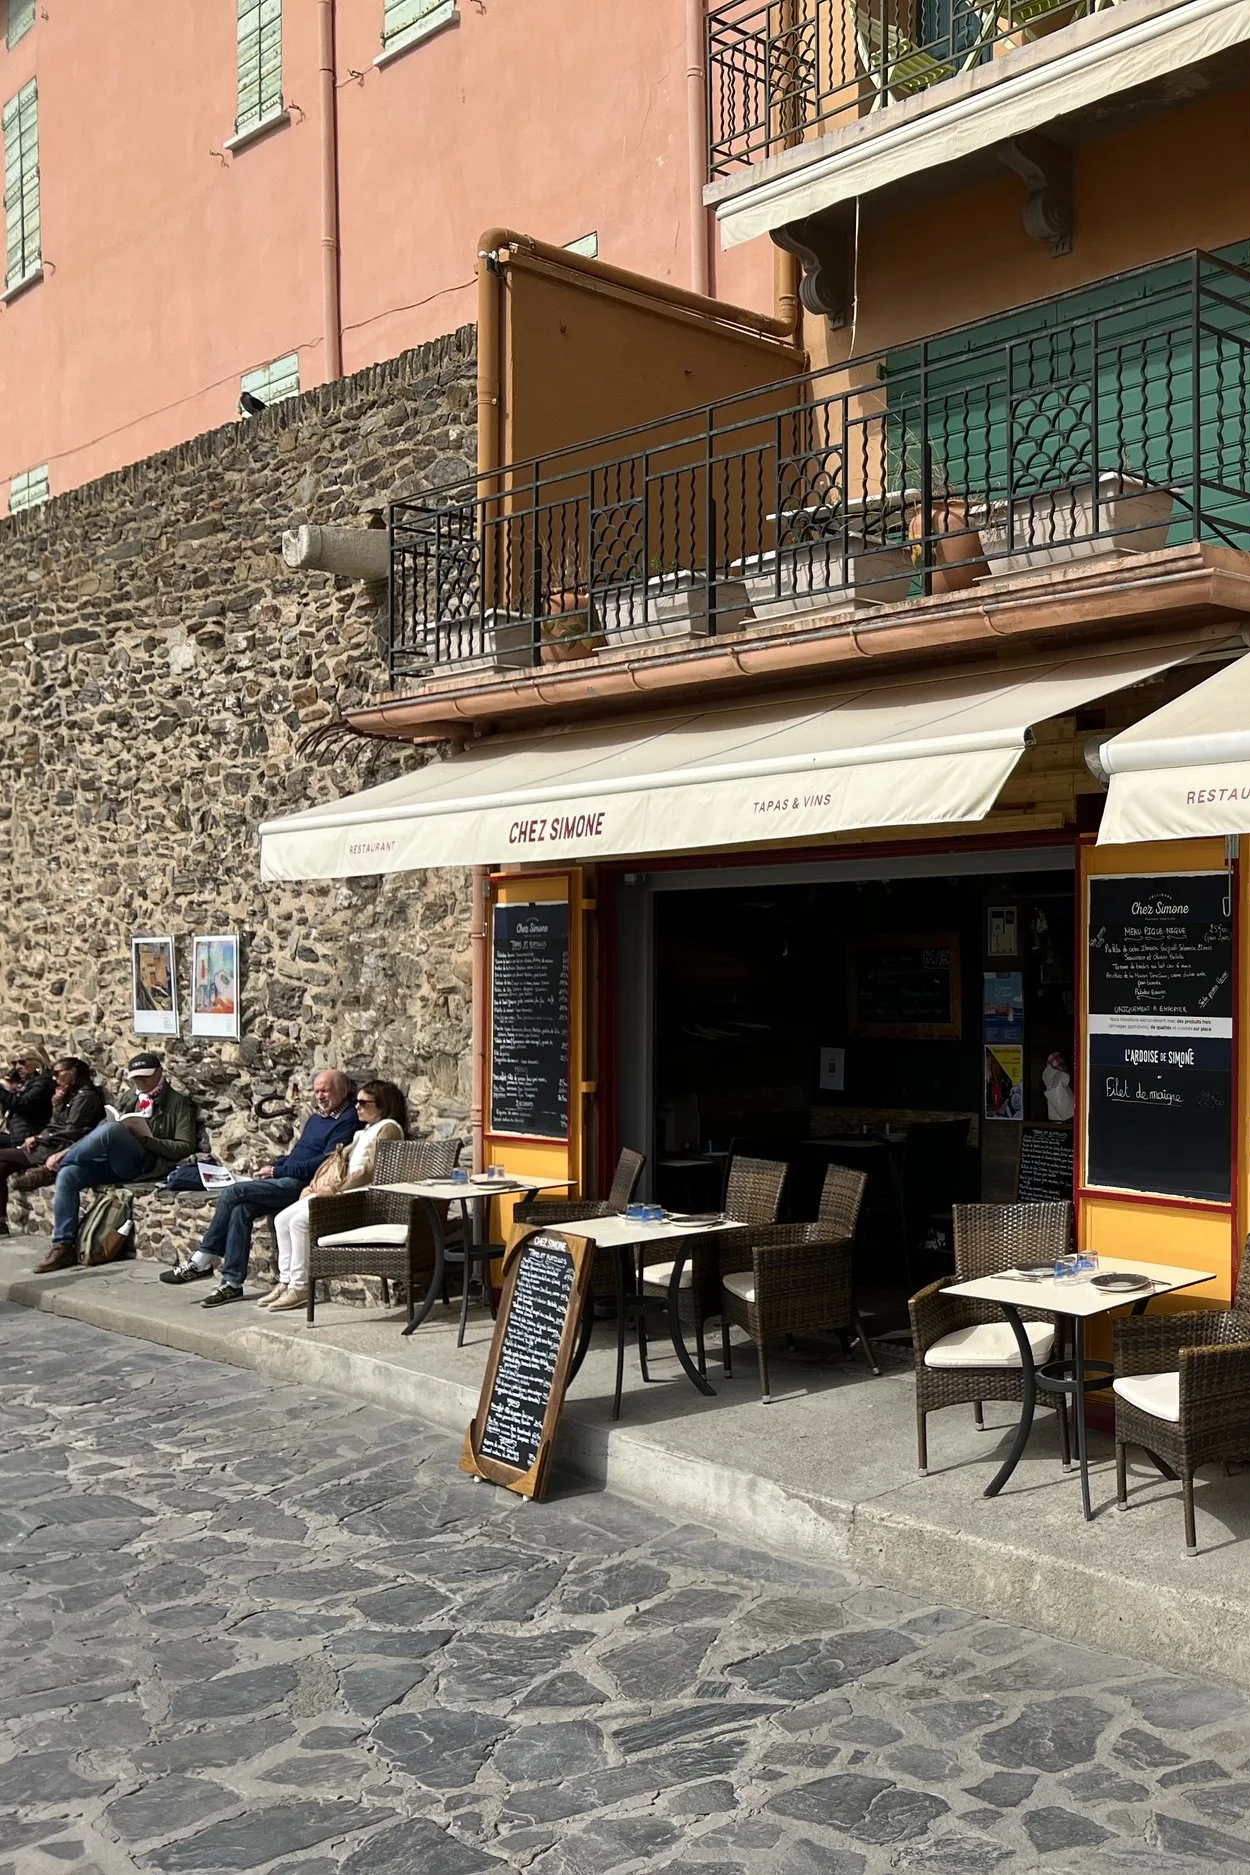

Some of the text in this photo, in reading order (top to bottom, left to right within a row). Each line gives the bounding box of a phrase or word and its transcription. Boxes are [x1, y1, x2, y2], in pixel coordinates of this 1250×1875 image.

[752, 794, 832, 813] TAPAS & VINS
[509, 812, 605, 844] CHEZ SIMONE
[349, 841, 395, 855] RESTAURANT
[1131, 901, 1190, 915] Chez Simone
[1125, 1048, 1194, 1068] L'ARDOISE DE SIMONE
[1106, 1077, 1130, 1098] Filet
[1136, 1082, 1148, 1100] de
